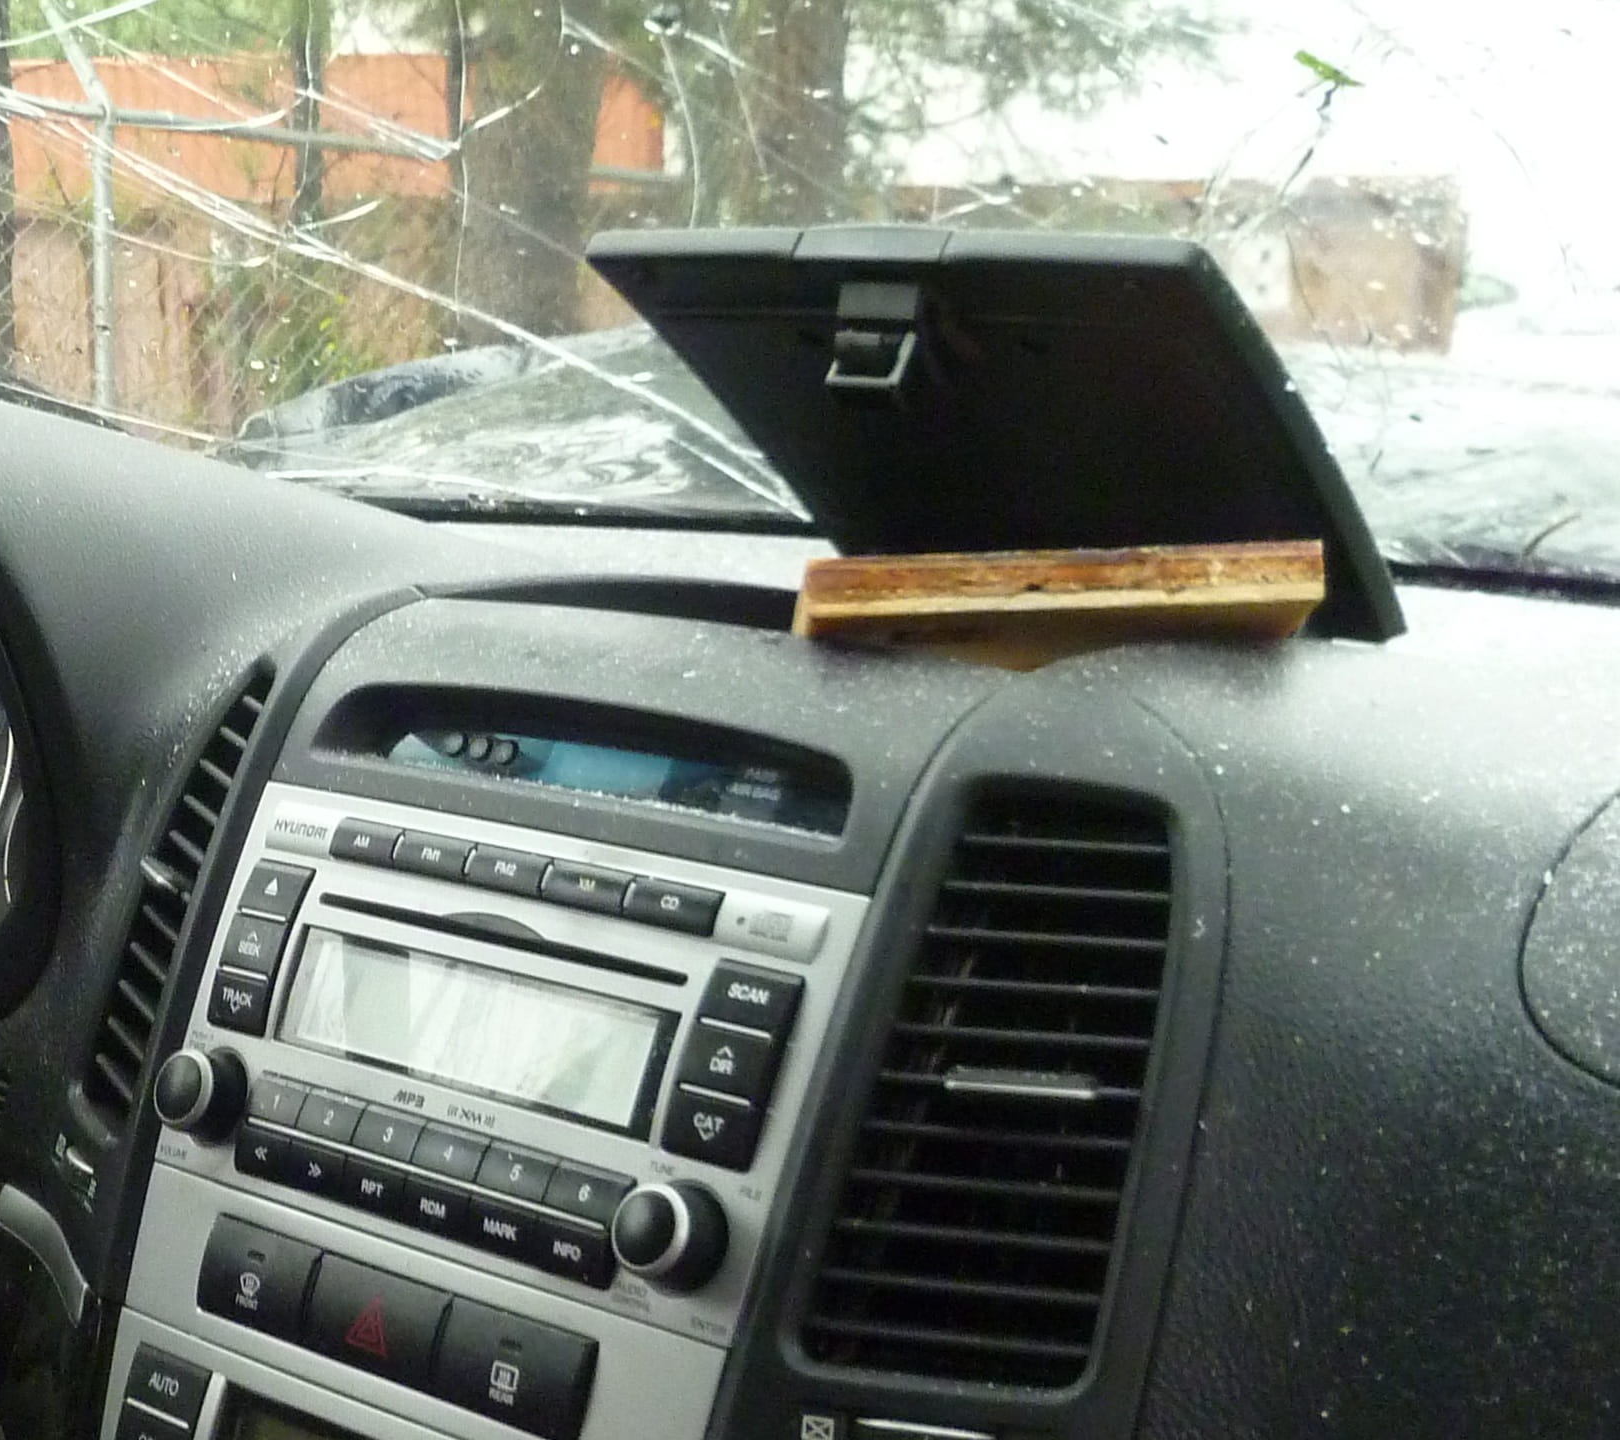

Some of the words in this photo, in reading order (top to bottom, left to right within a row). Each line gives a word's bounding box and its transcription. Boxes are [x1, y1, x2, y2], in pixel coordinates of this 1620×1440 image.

[273, 819, 328, 840] HYUNDAI
[353, 833, 371, 849] AM
[421, 846, 442, 863] FM1
[493, 861, 517, 877] FM2
[660, 895, 679, 911] CD
[238, 940, 262, 958] SEEK
[222, 987, 253, 1008] TRACK
[727, 981, 771, 1006] SCAN
[709, 1056, 736, 1076] DIR
[273, 1094, 280, 1109] 1
[323, 1110, 334, 1126] 2
[692, 1111, 726, 1132] CAT
[383, 1126, 394, 1143] 3
[443, 1145, 454, 1161] 4
[509, 1163, 523, 1181] 5
[361, 1178, 384, 1198] RPT
[578, 1184, 592, 1202] 6
[419, 1196, 446, 1219] RDM
[483, 1216, 518, 1241] MARK
[552, 1240, 581, 1262] INFO
[235, 1292, 258, 1311] FRONT
[148, 1371, 180, 1397] AUTO
[488, 1386, 515, 1408] REAR
